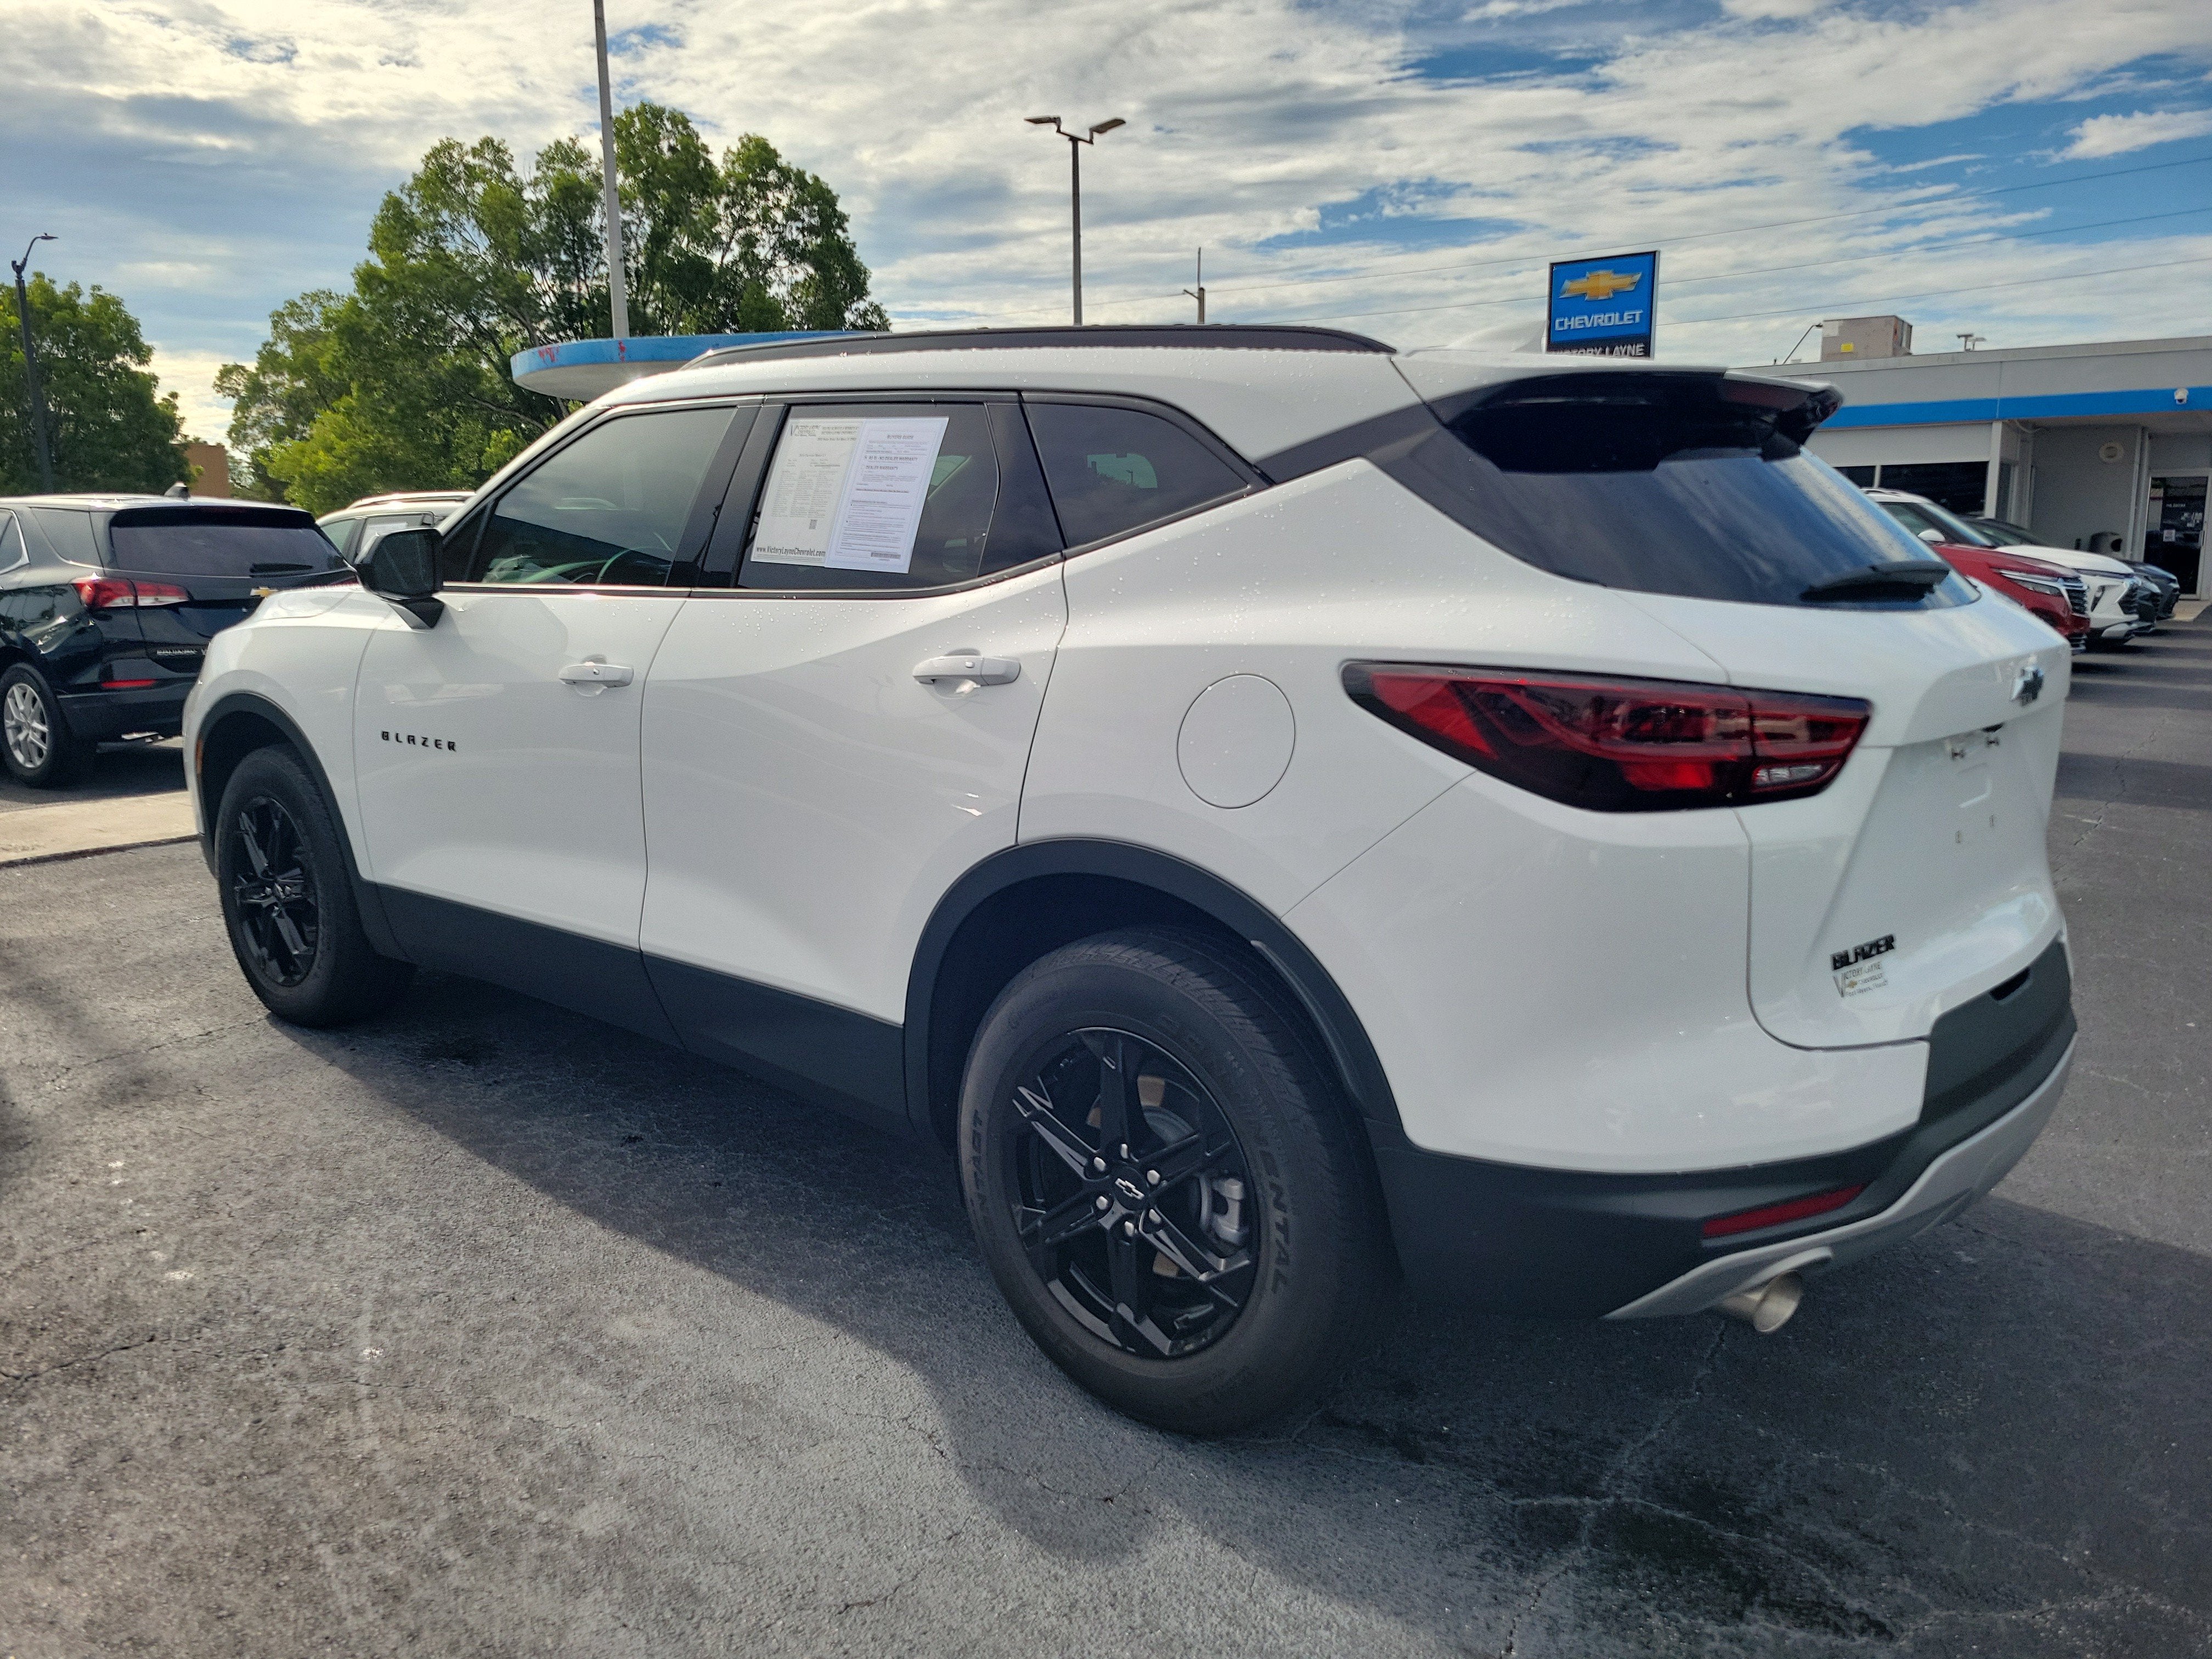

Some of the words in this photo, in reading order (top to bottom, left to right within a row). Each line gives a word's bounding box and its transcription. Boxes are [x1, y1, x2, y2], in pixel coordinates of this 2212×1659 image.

[1555, 309, 1643, 331] CHEVROLET
[1605, 343, 1645, 357] LAYNE
[756, 546, 826, 557] www.VictoryLayneChevrolet.com
[381, 731, 456, 752] BLAZER
